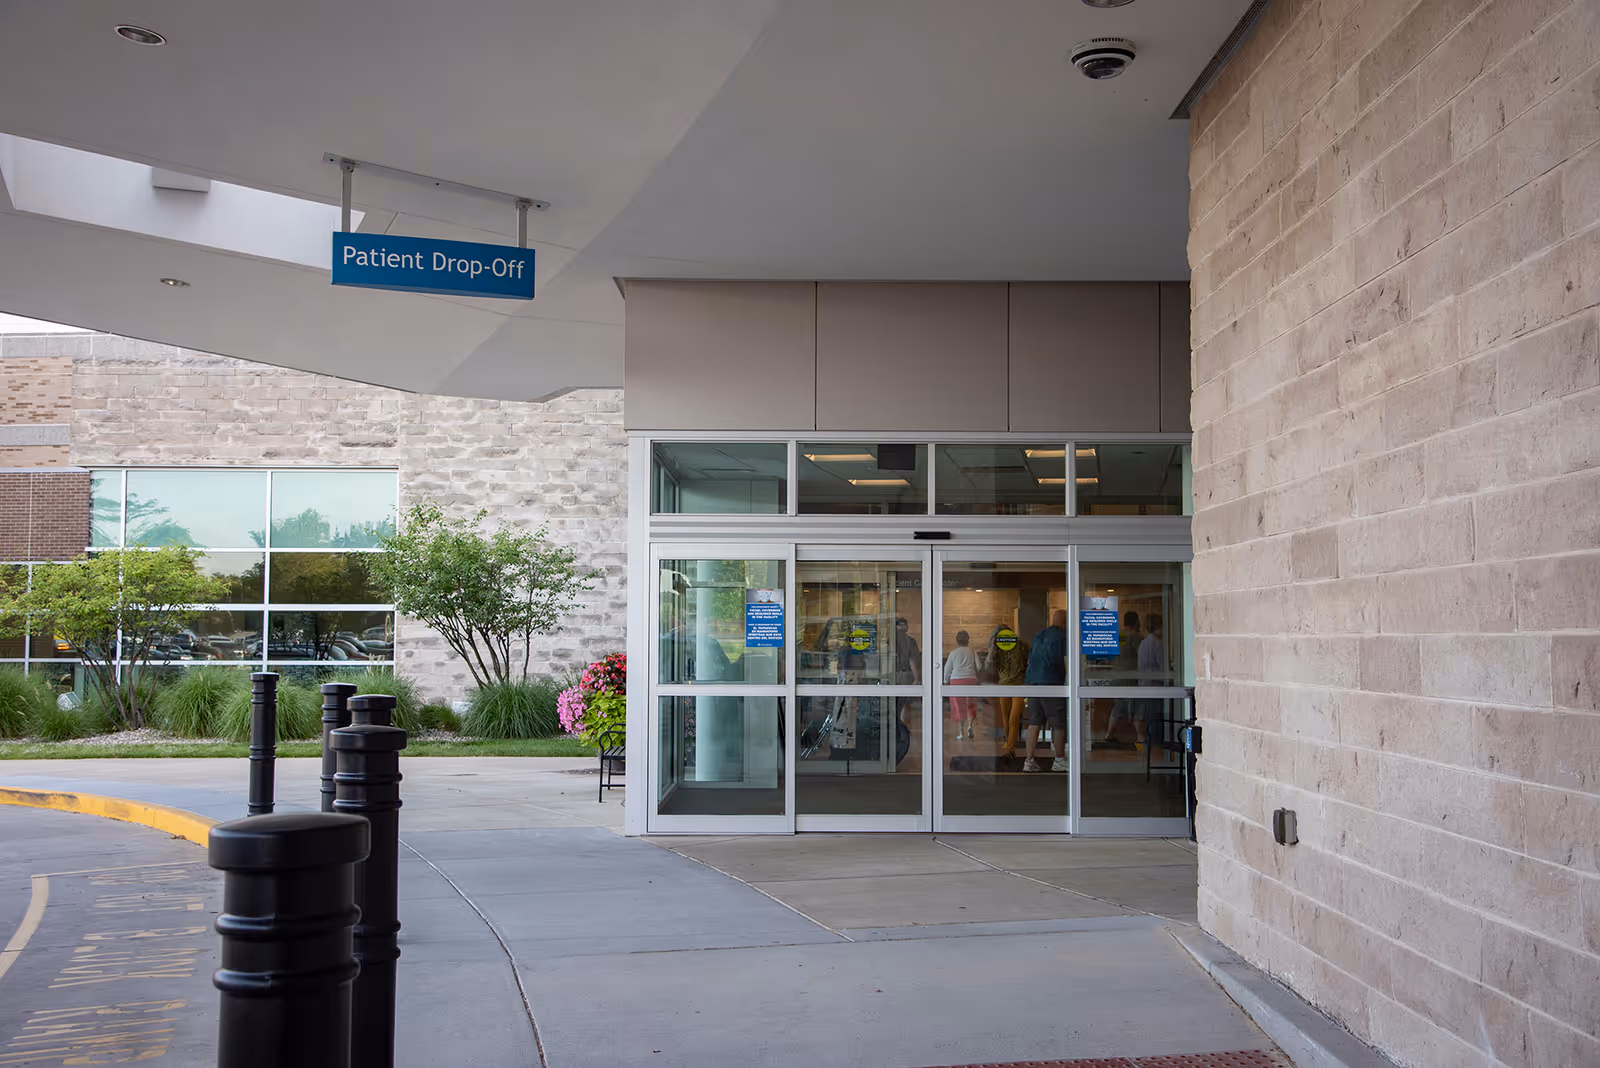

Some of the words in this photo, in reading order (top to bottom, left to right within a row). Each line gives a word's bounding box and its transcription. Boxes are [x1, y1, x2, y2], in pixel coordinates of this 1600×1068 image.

[343, 245, 424, 270] Patient
[432, 252, 525, 279] Drop-Off
[47, 925, 208, 989] BLOCK
[0, 998, 188, 1066] RAMP
